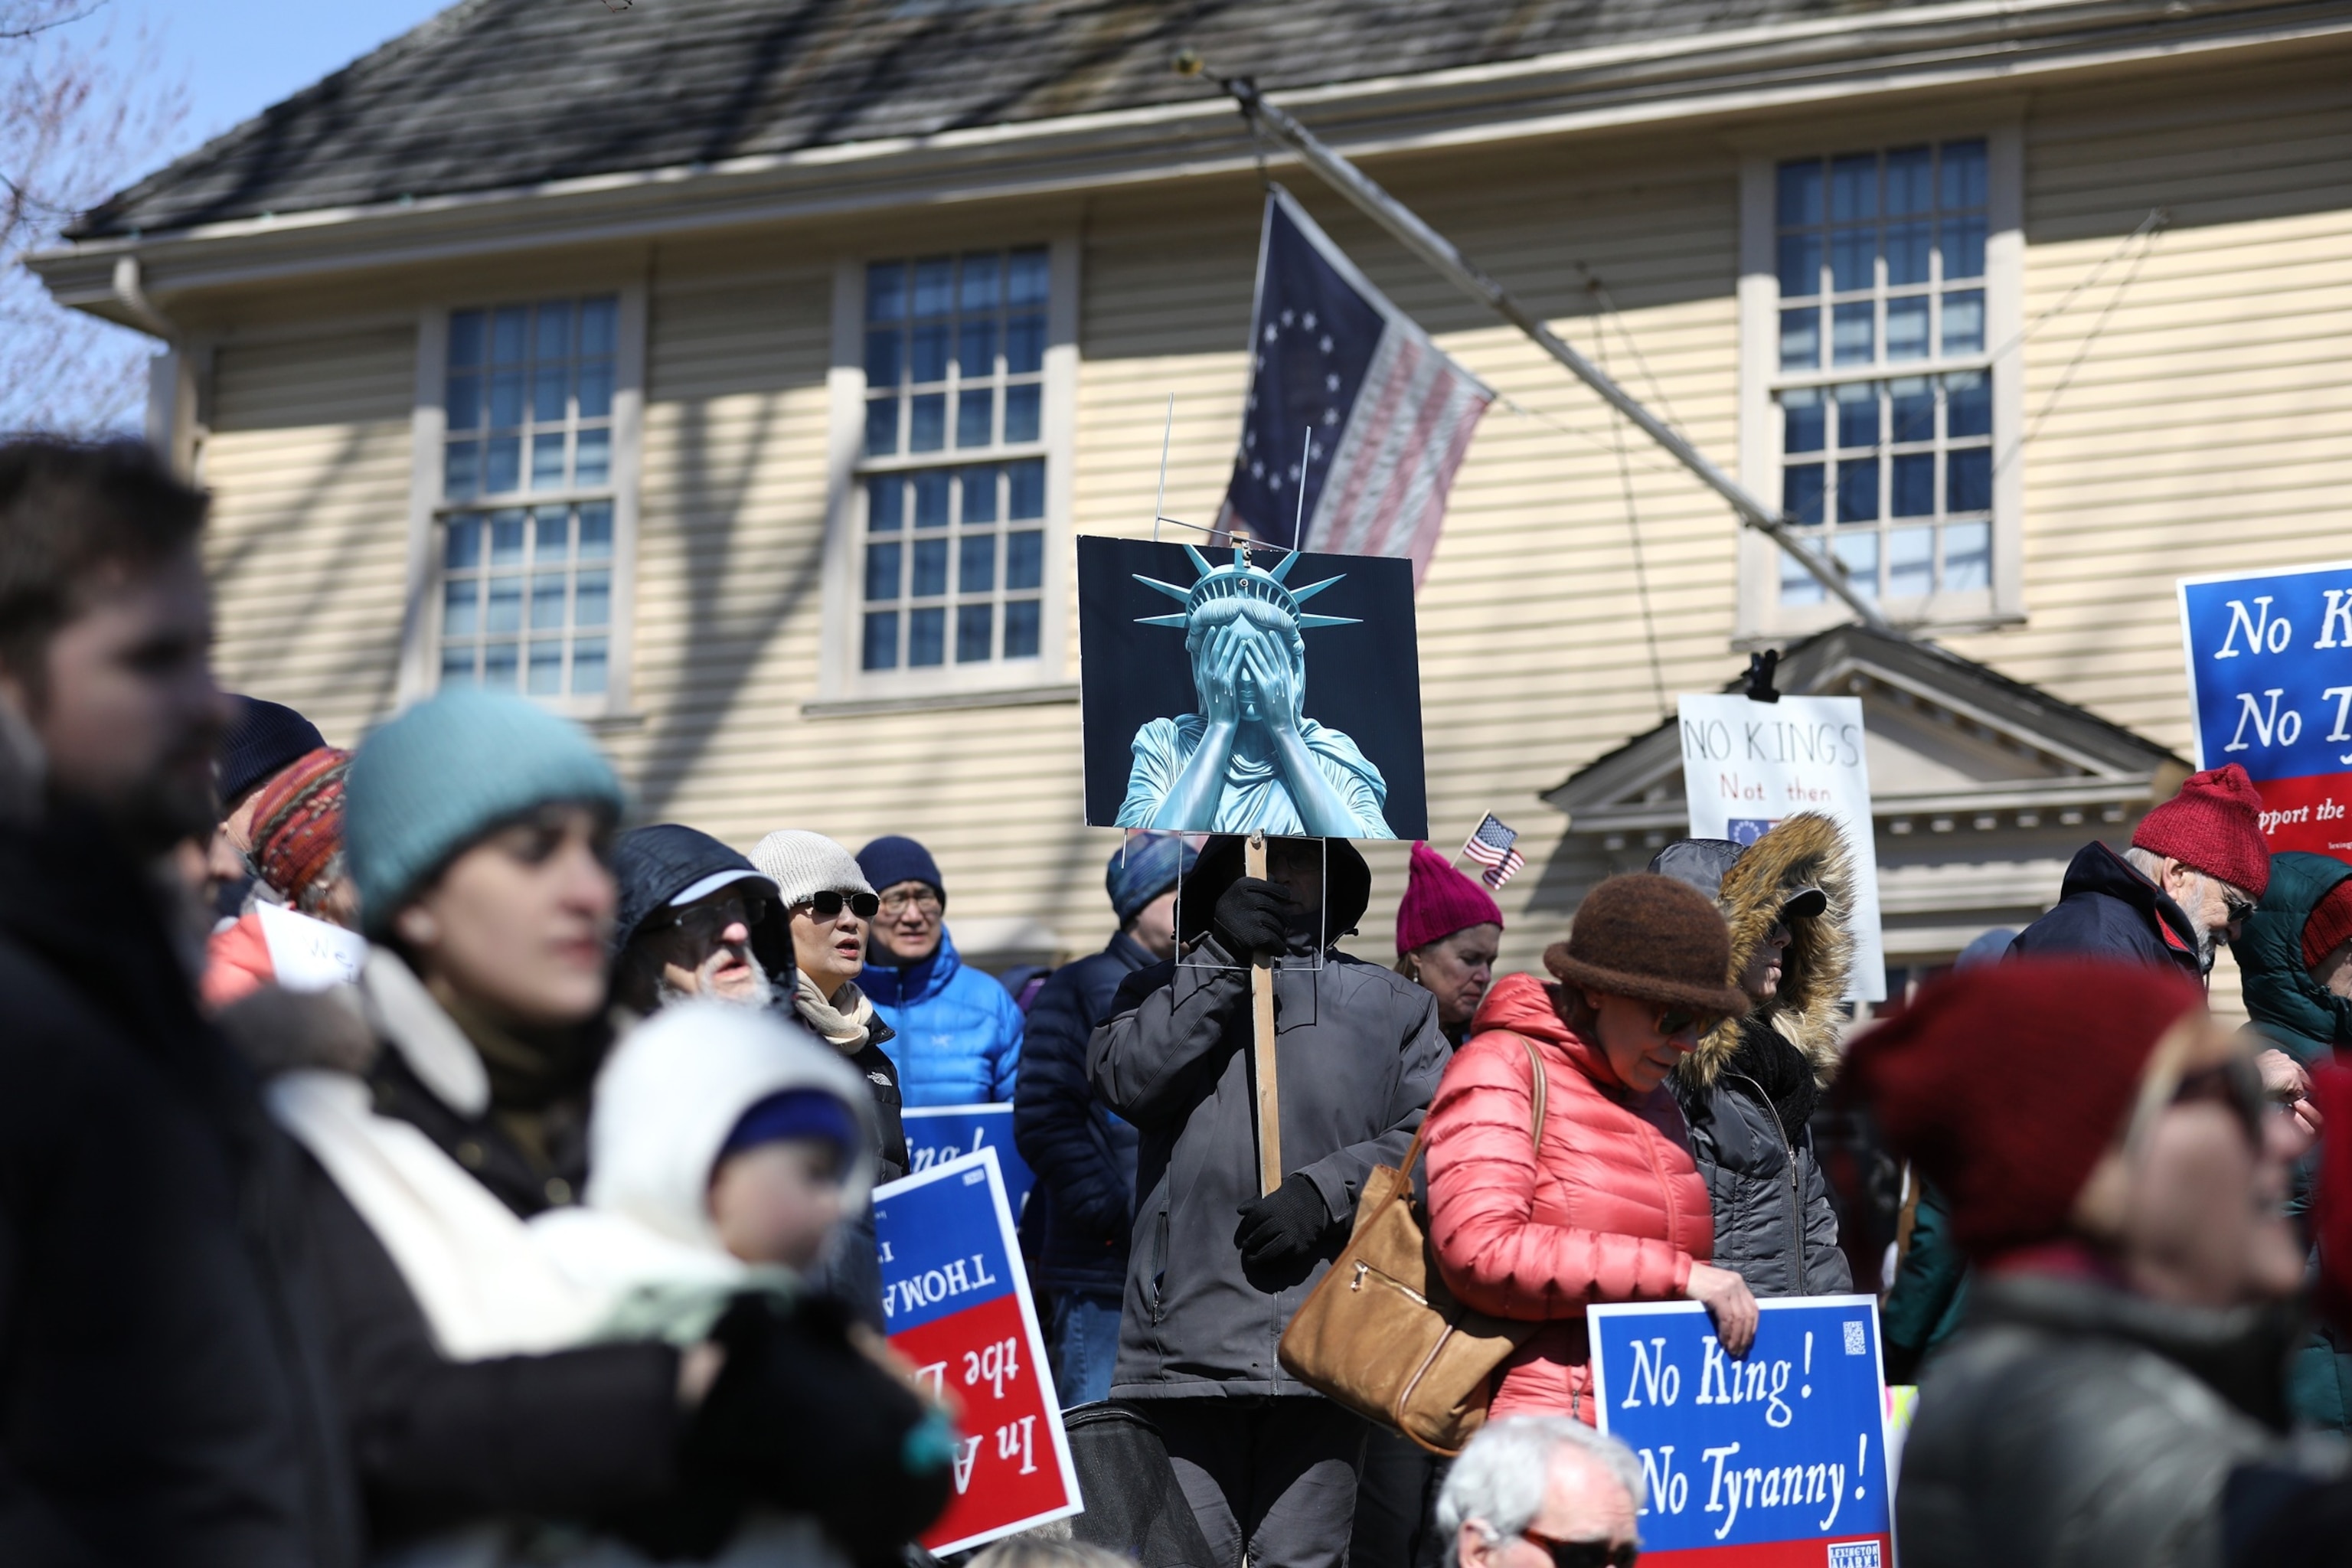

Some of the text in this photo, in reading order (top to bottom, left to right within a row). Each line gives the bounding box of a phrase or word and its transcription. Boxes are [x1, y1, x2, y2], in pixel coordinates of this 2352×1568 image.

[2214, 596, 2292, 660] No
[1684, 719, 1860, 768] NO KINGS
[2223, 688, 2302, 753] No
[1720, 773, 1831, 802] Not then
[2258, 797, 2345, 835] pport the
[882, 1253, 995, 1319] THOMA
[963, 1337, 1020, 1400] the
[1622, 1331, 1814, 1429] No King!
[995, 1413, 1038, 1476] In
[1637, 1432, 1867, 1540] No Tyranny!
